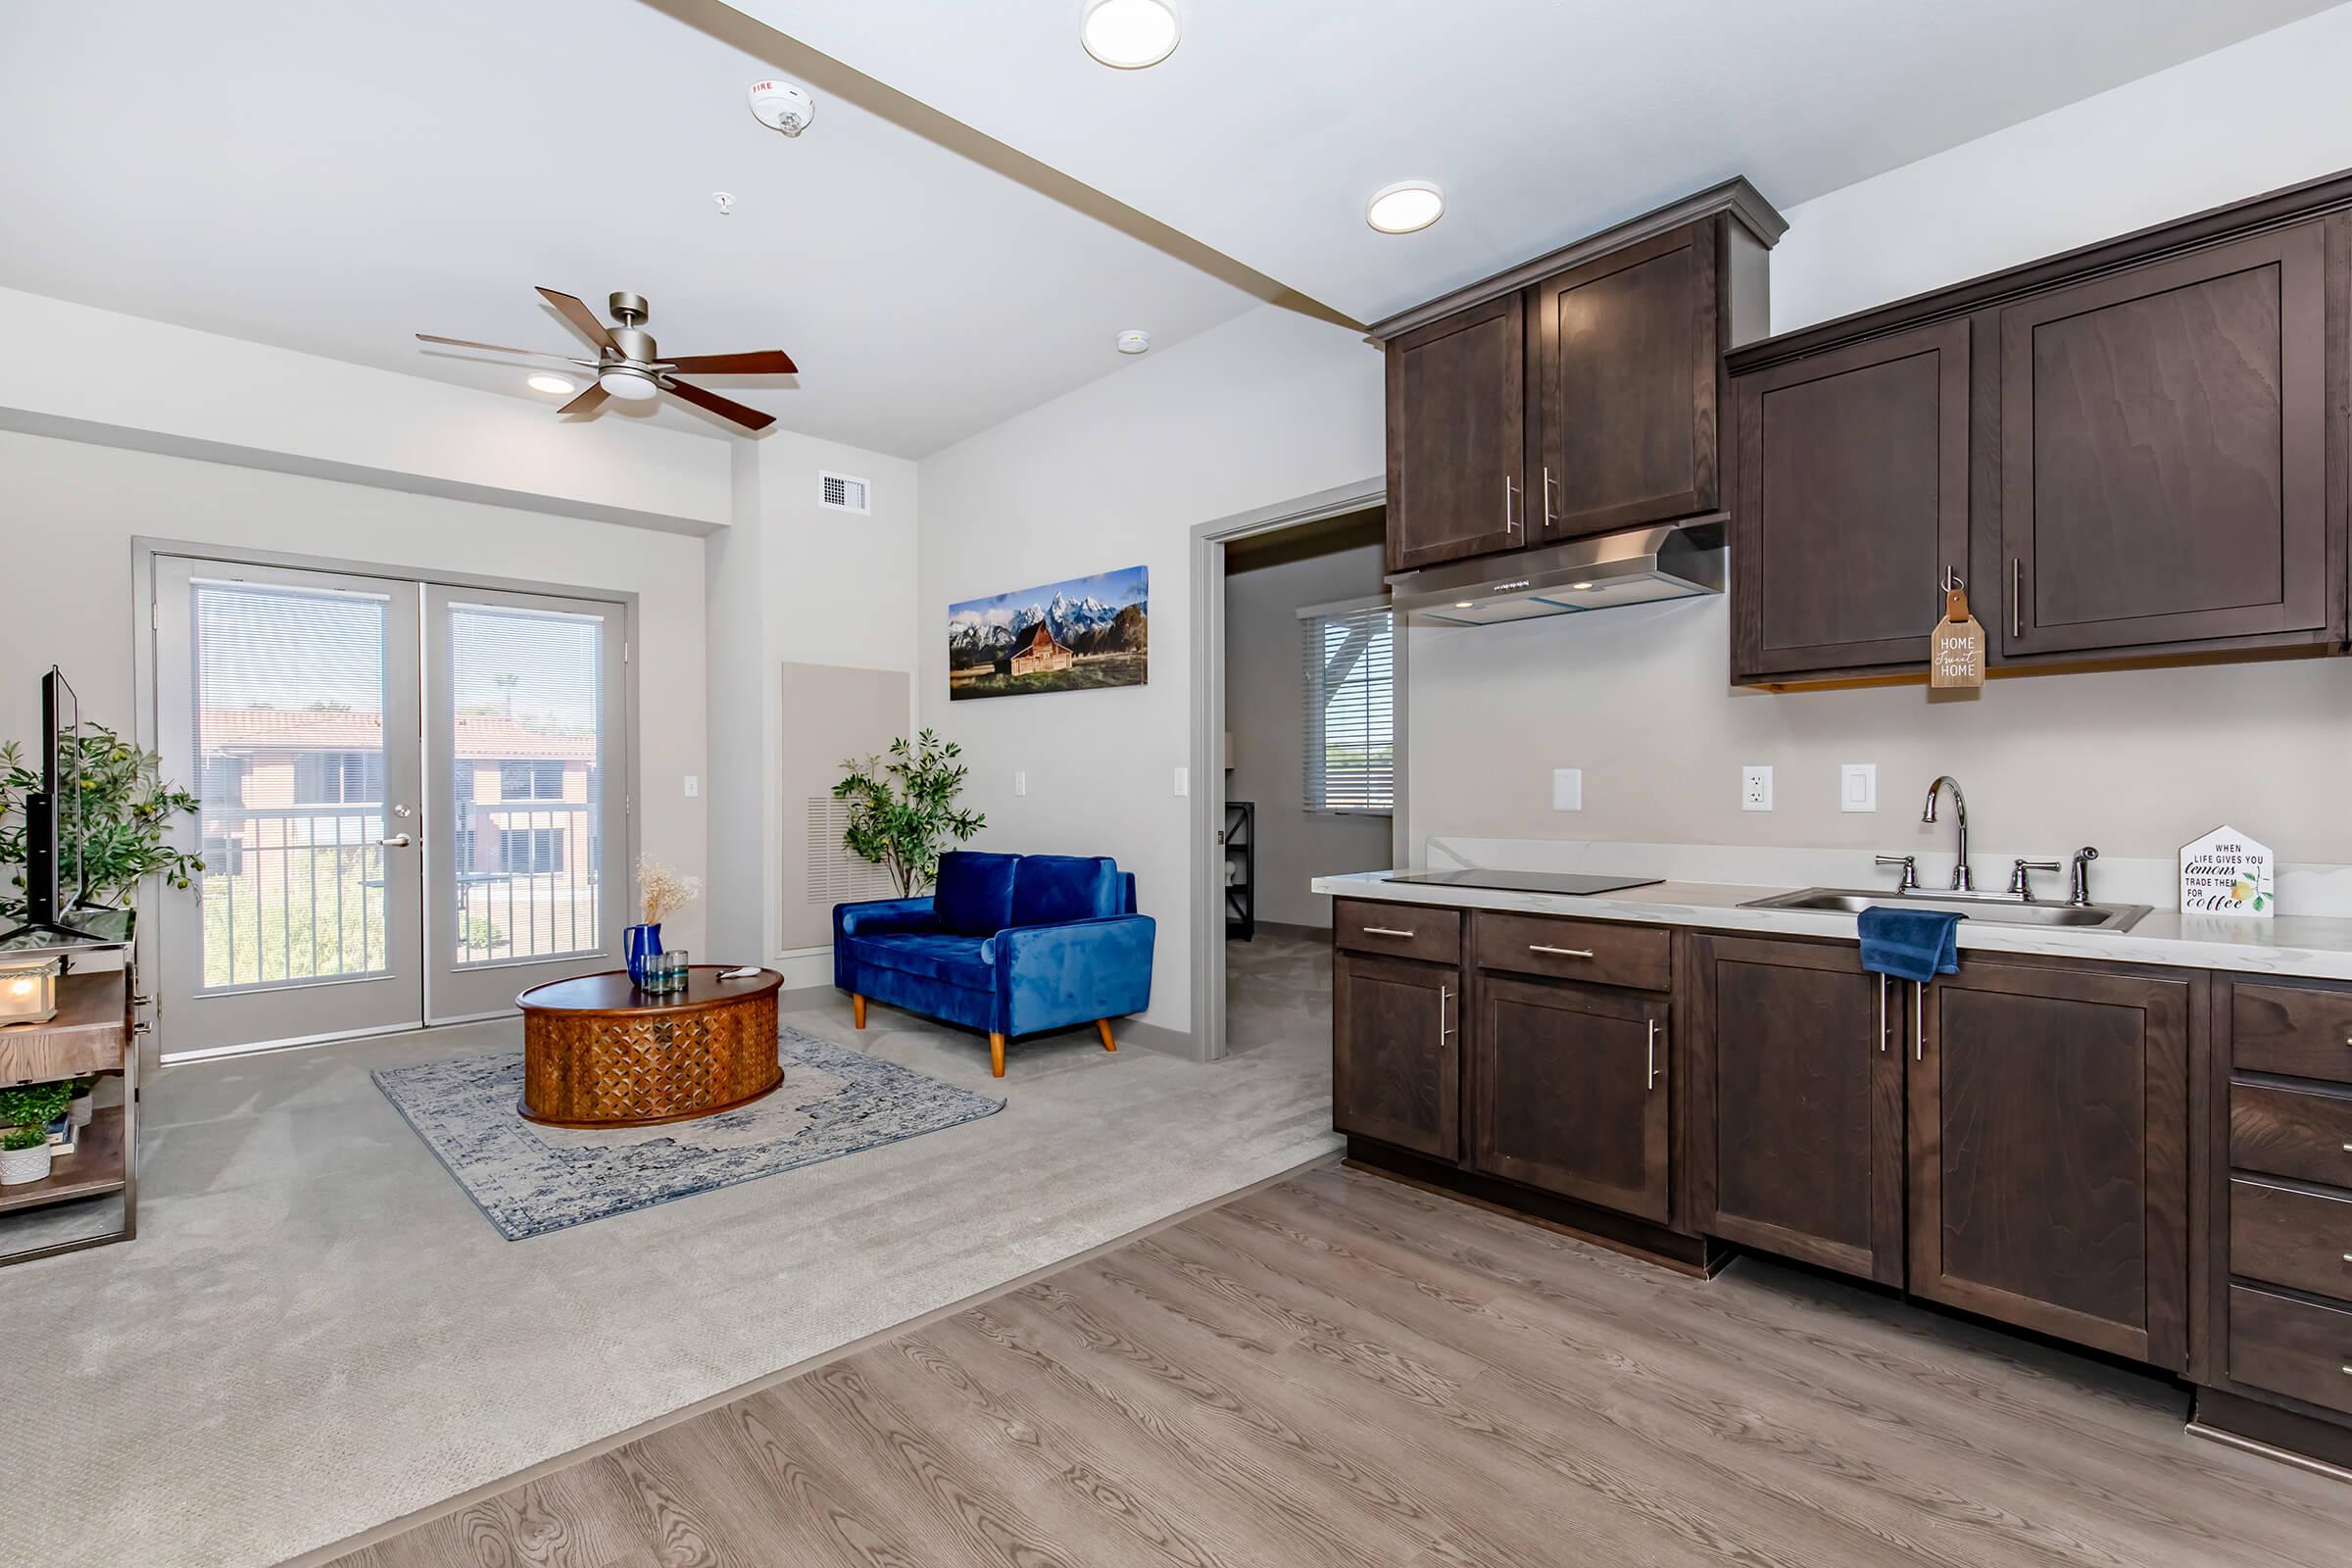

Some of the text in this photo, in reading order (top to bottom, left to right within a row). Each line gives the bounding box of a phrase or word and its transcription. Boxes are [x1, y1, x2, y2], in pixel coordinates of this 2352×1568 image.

[753, 82, 773, 93] FIRE
[1941, 637, 1975, 650] HOME
[1941, 664, 1976, 676] HOME
[2215, 844, 2241, 853] WHEN
[2194, 855, 2213, 863] LIFE
[2245, 856, 2264, 864] YOU
[2184, 861, 2235, 875] lemons
[2185, 878, 2237, 887] TRADE THEM
[2187, 889, 2203, 898] FOR
[2186, 895, 2242, 910] coffee
